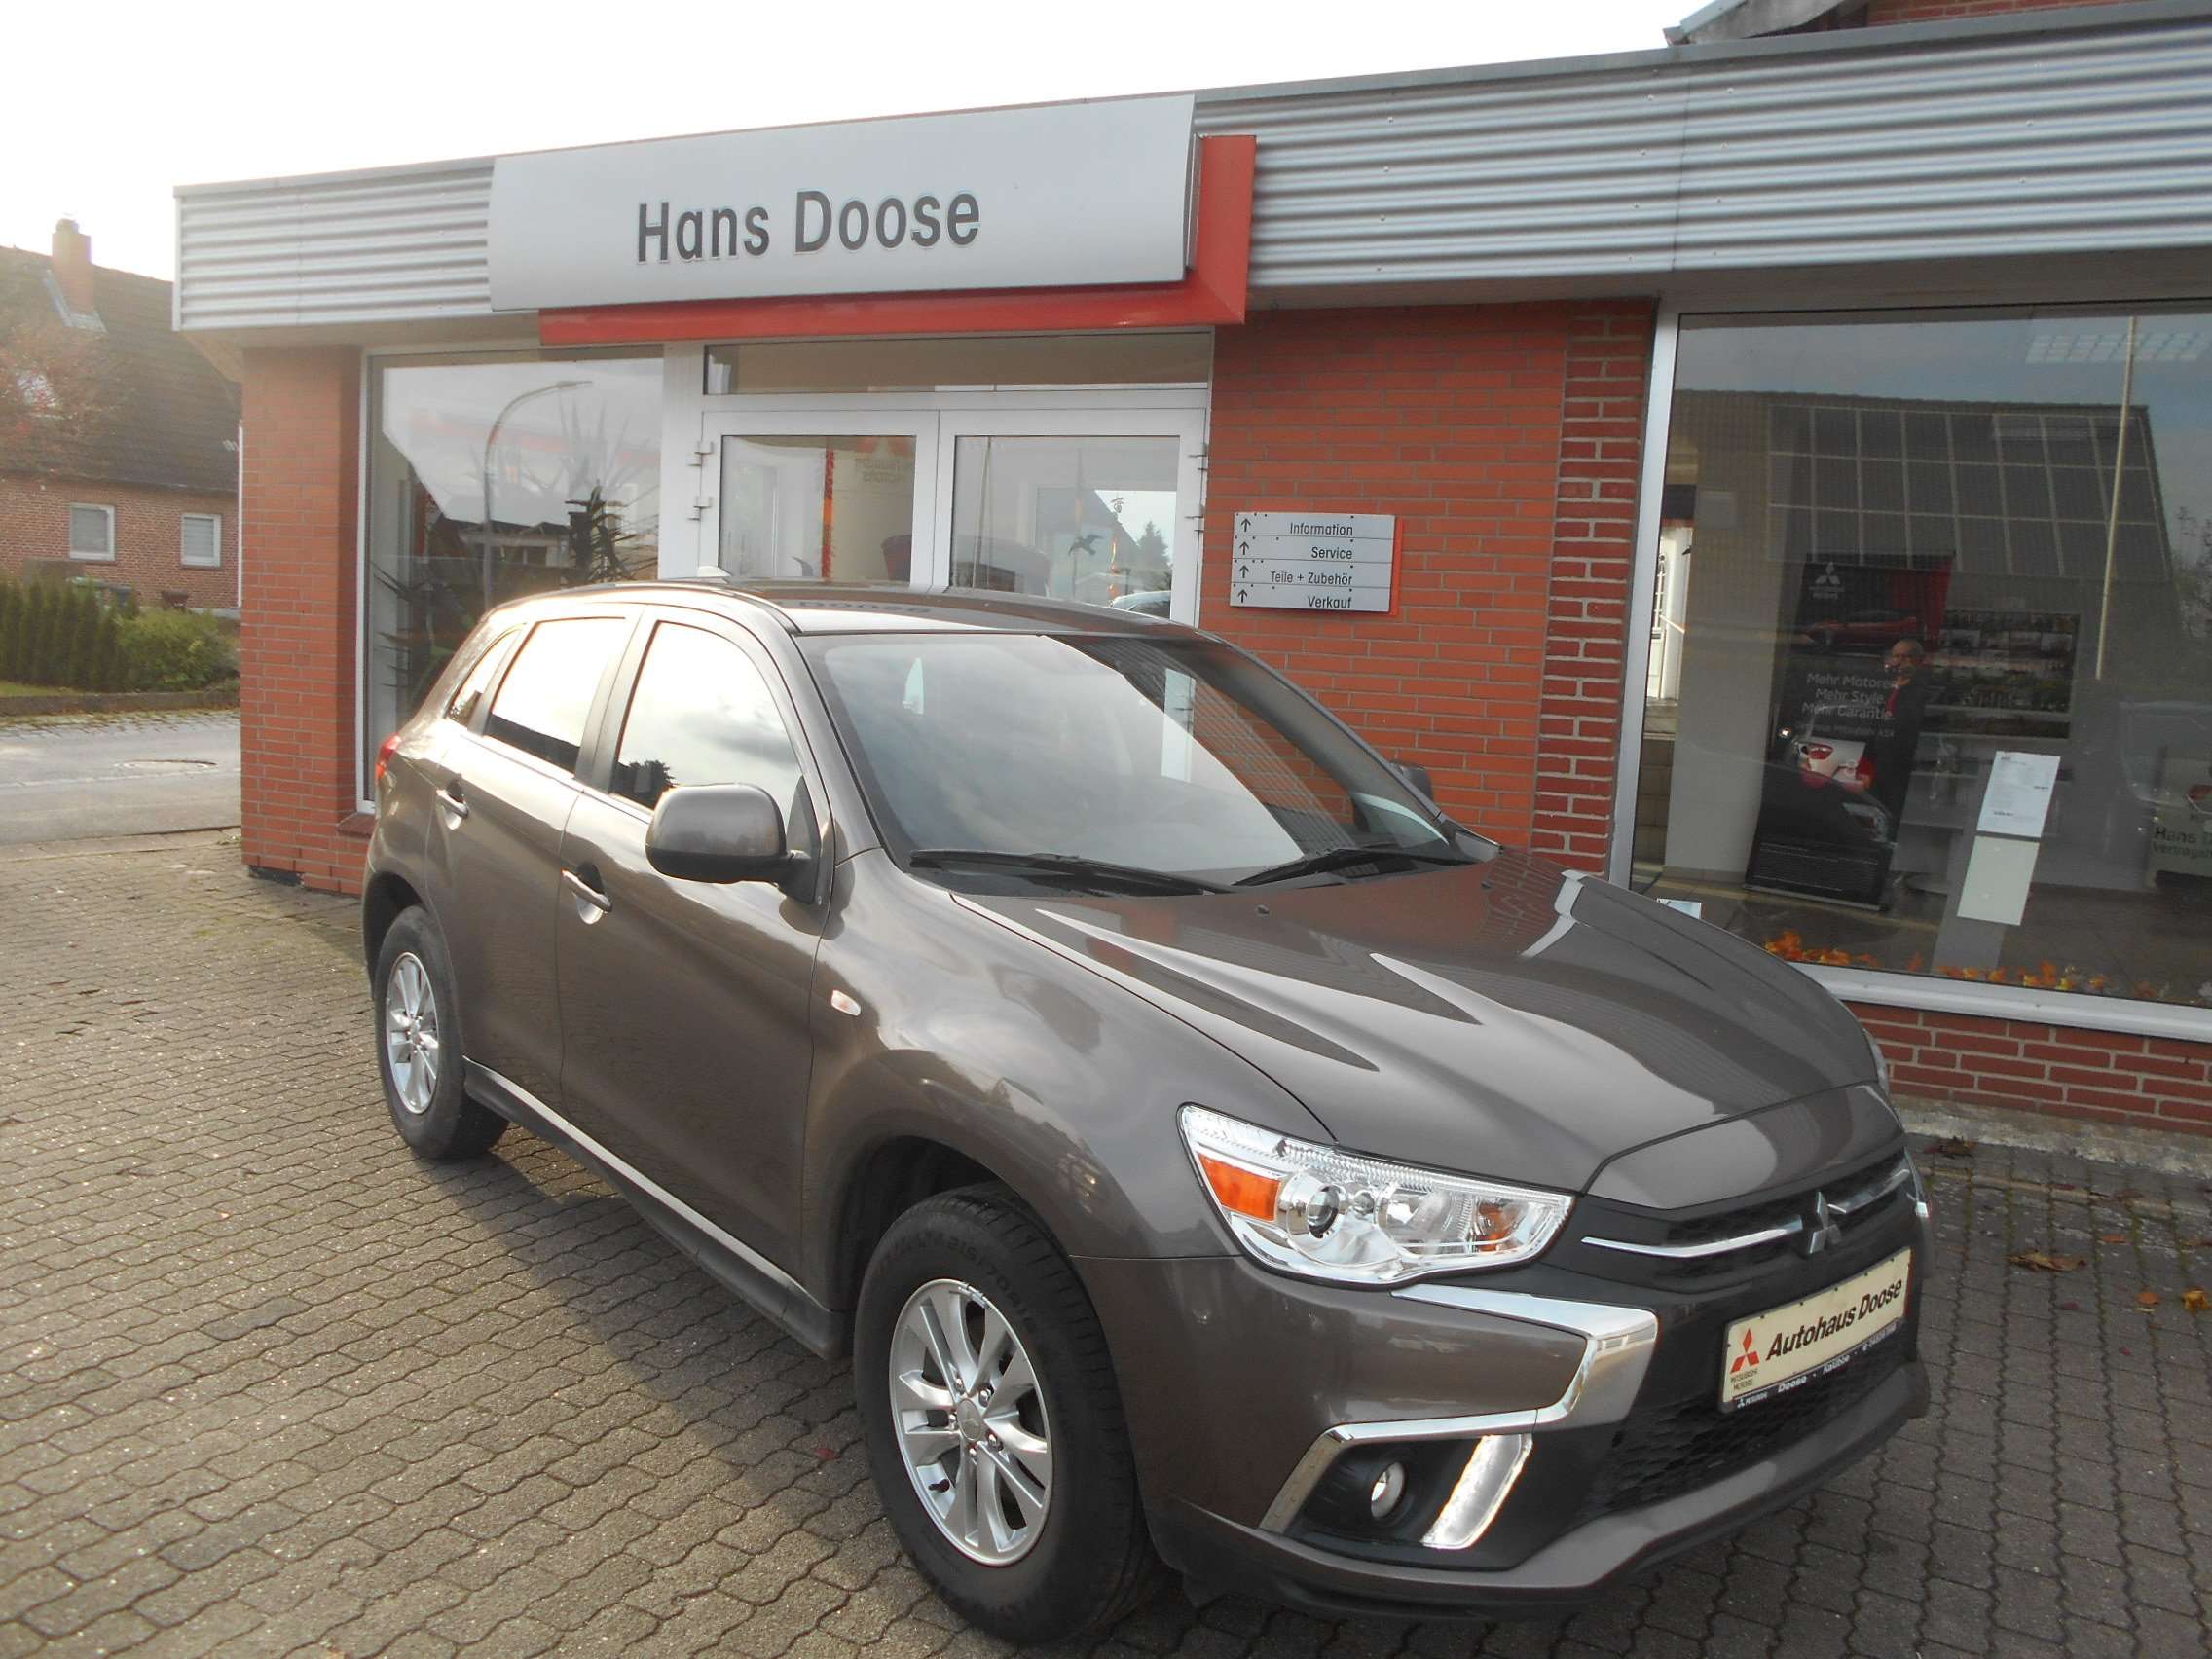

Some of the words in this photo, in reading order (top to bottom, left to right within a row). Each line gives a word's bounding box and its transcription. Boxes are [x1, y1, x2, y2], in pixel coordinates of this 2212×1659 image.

[638, 201, 770, 263] Hans
[793, 190, 979, 255] Doose
[1289, 522, 1353, 536] Information
[1310, 546, 1353, 560] Service
[1270, 571, 1294, 583] Teile
[1308, 571, 1353, 585] Zubehör
[1307, 595, 1353, 609] Verkauf
[1806, 672, 1839, 685] Mehr
[1815, 687, 1848, 701] Mehr
[1765, 1305, 1856, 1361] Autohaus
[1858, 1278, 1902, 1321] Doose
